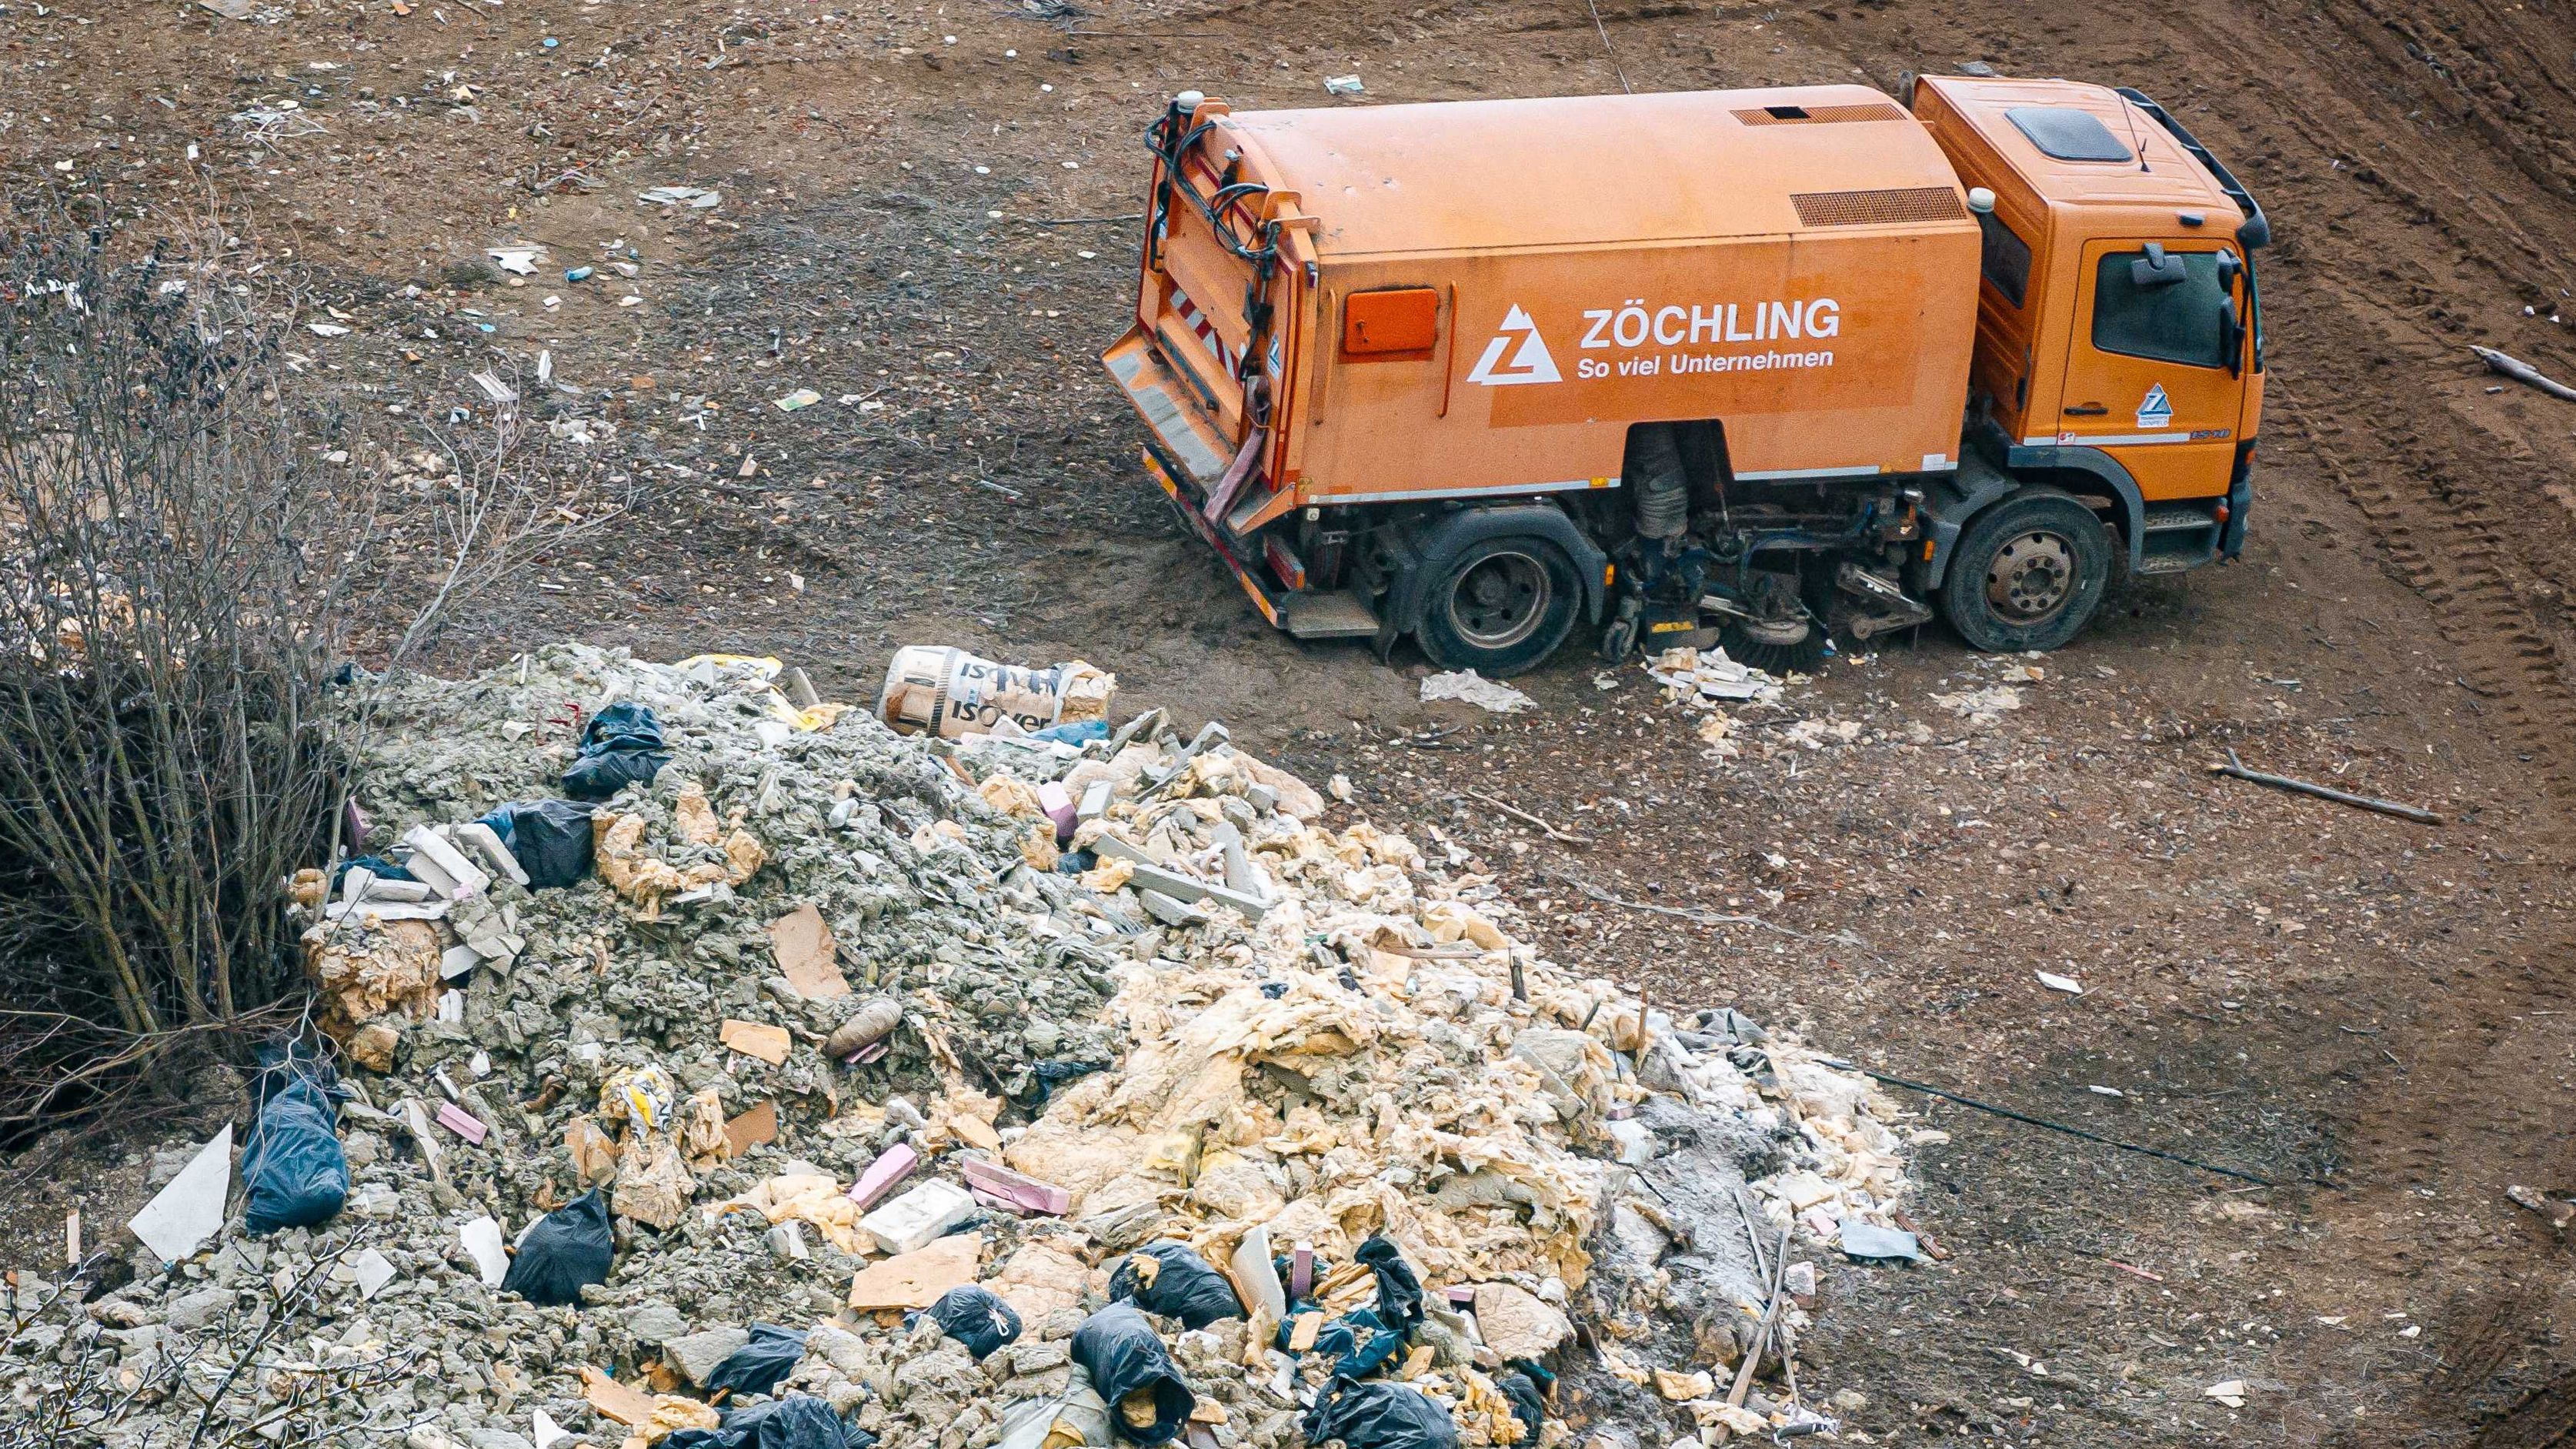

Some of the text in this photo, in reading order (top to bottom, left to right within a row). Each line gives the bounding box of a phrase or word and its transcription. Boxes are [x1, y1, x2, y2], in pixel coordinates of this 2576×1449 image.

[1580, 298, 1840, 349] ZÖCHLING
[1577, 350, 1834, 379] So viel Unternehmen
